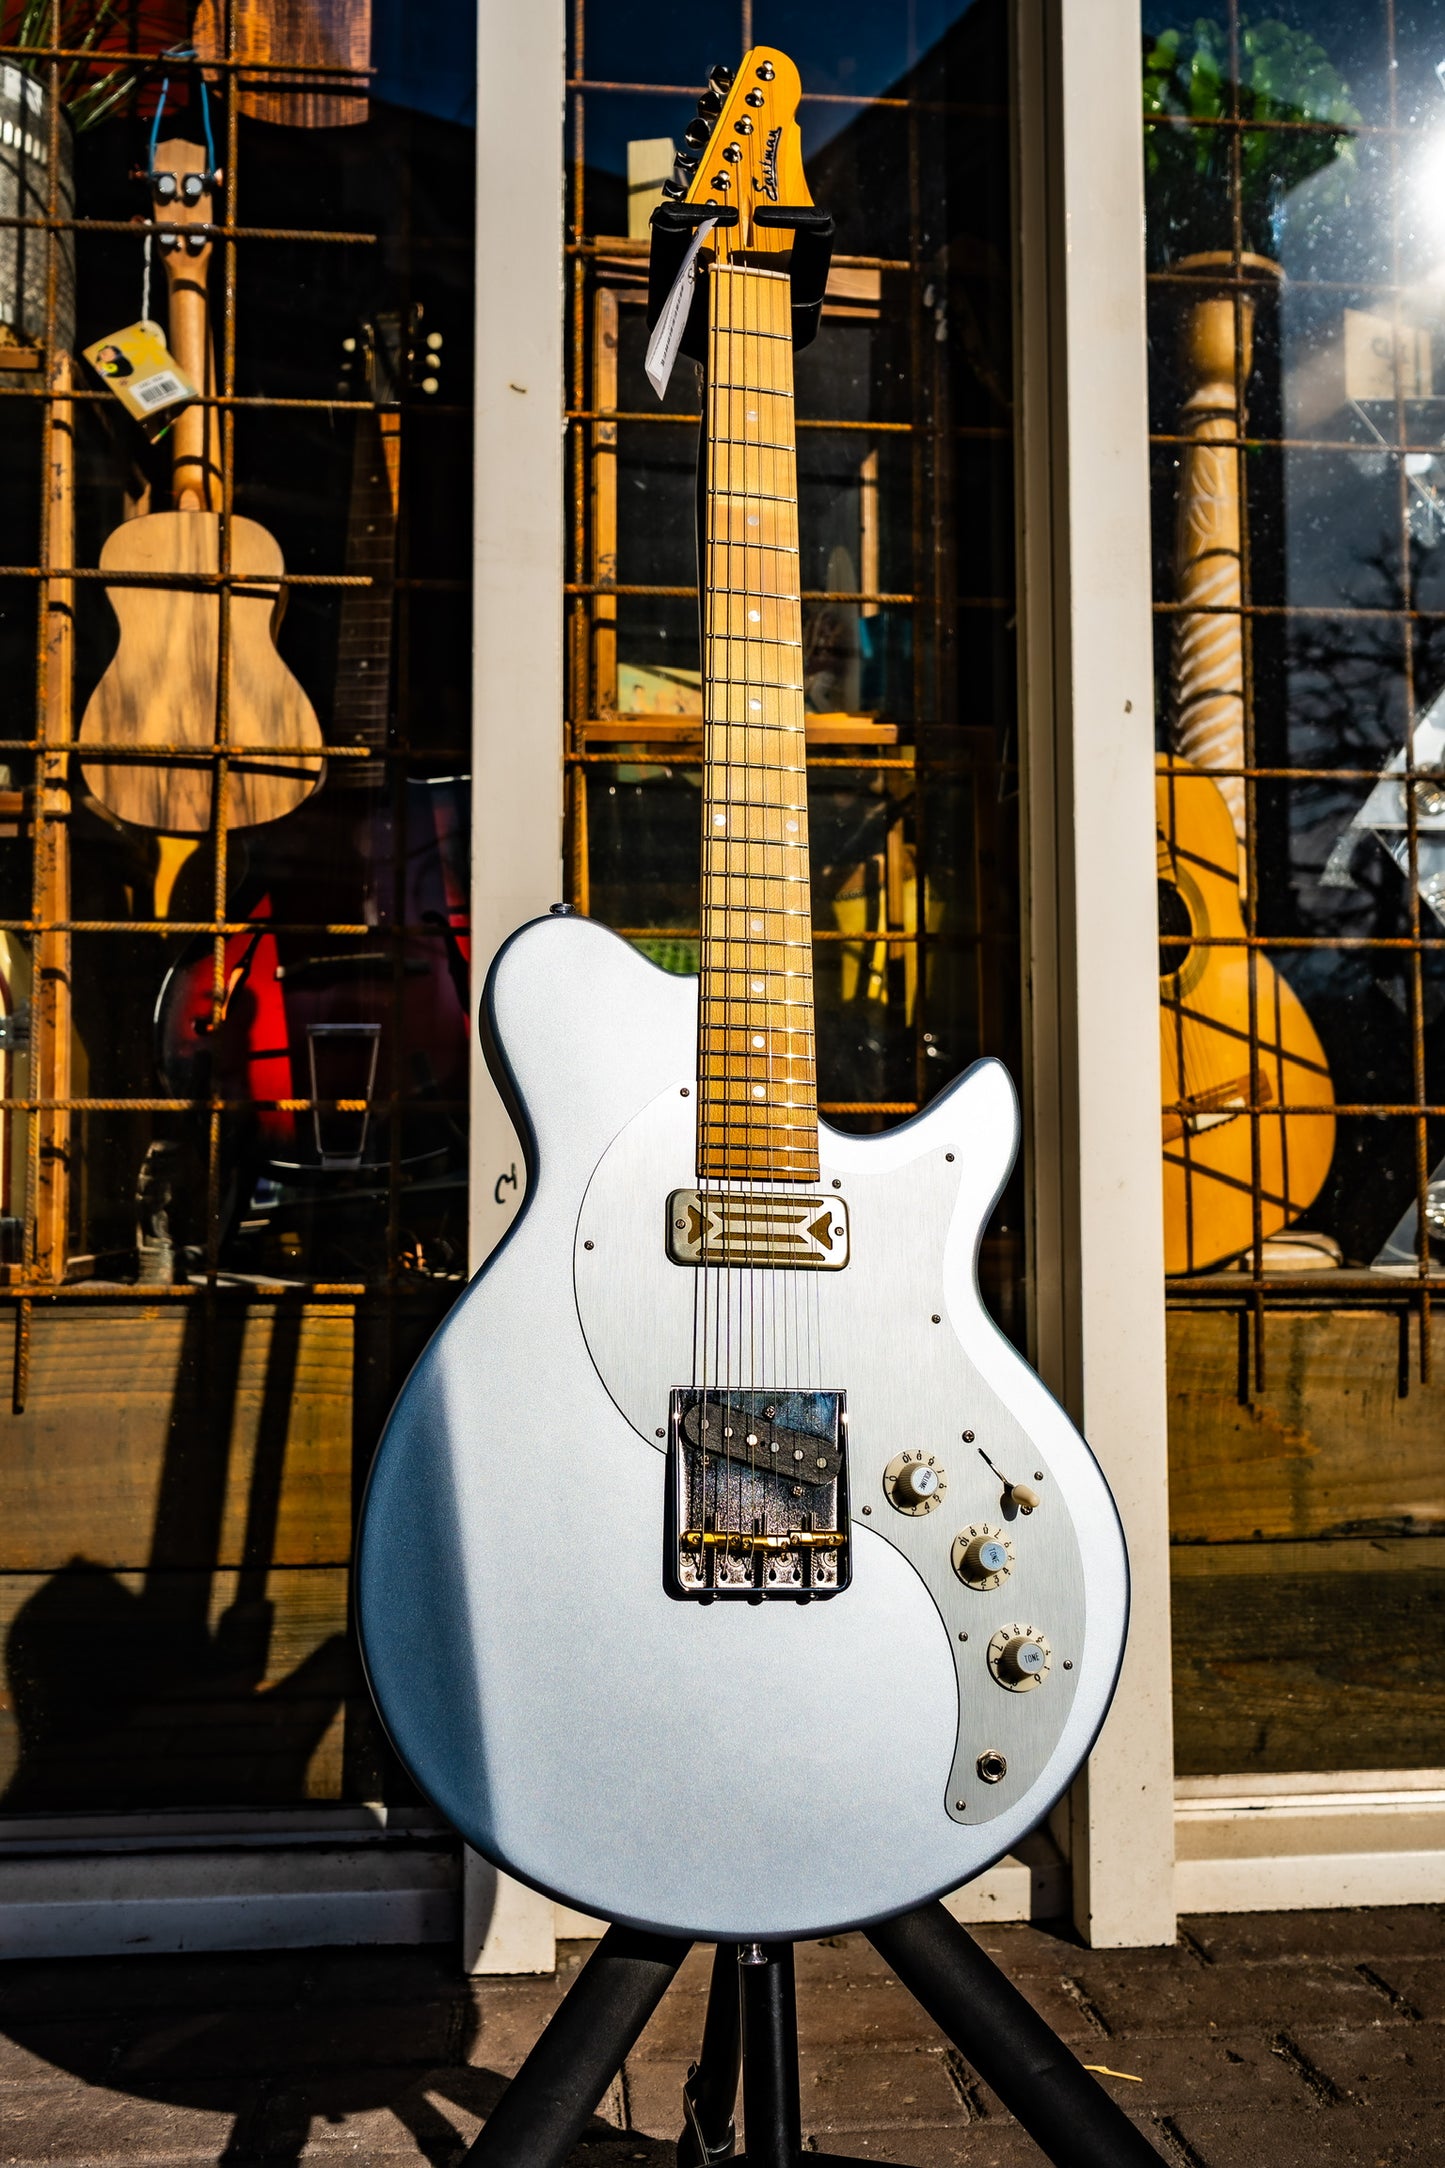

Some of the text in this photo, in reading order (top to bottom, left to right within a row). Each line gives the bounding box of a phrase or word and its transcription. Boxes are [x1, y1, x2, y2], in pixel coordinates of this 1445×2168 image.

[752, 126, 782, 201] Eastman
[902, 1454, 912, 1463] 10
[960, 1536, 970, 1547] 10
[988, 1547, 1000, 1564] TONE
[1023, 1651, 1040, 1663] TONE
